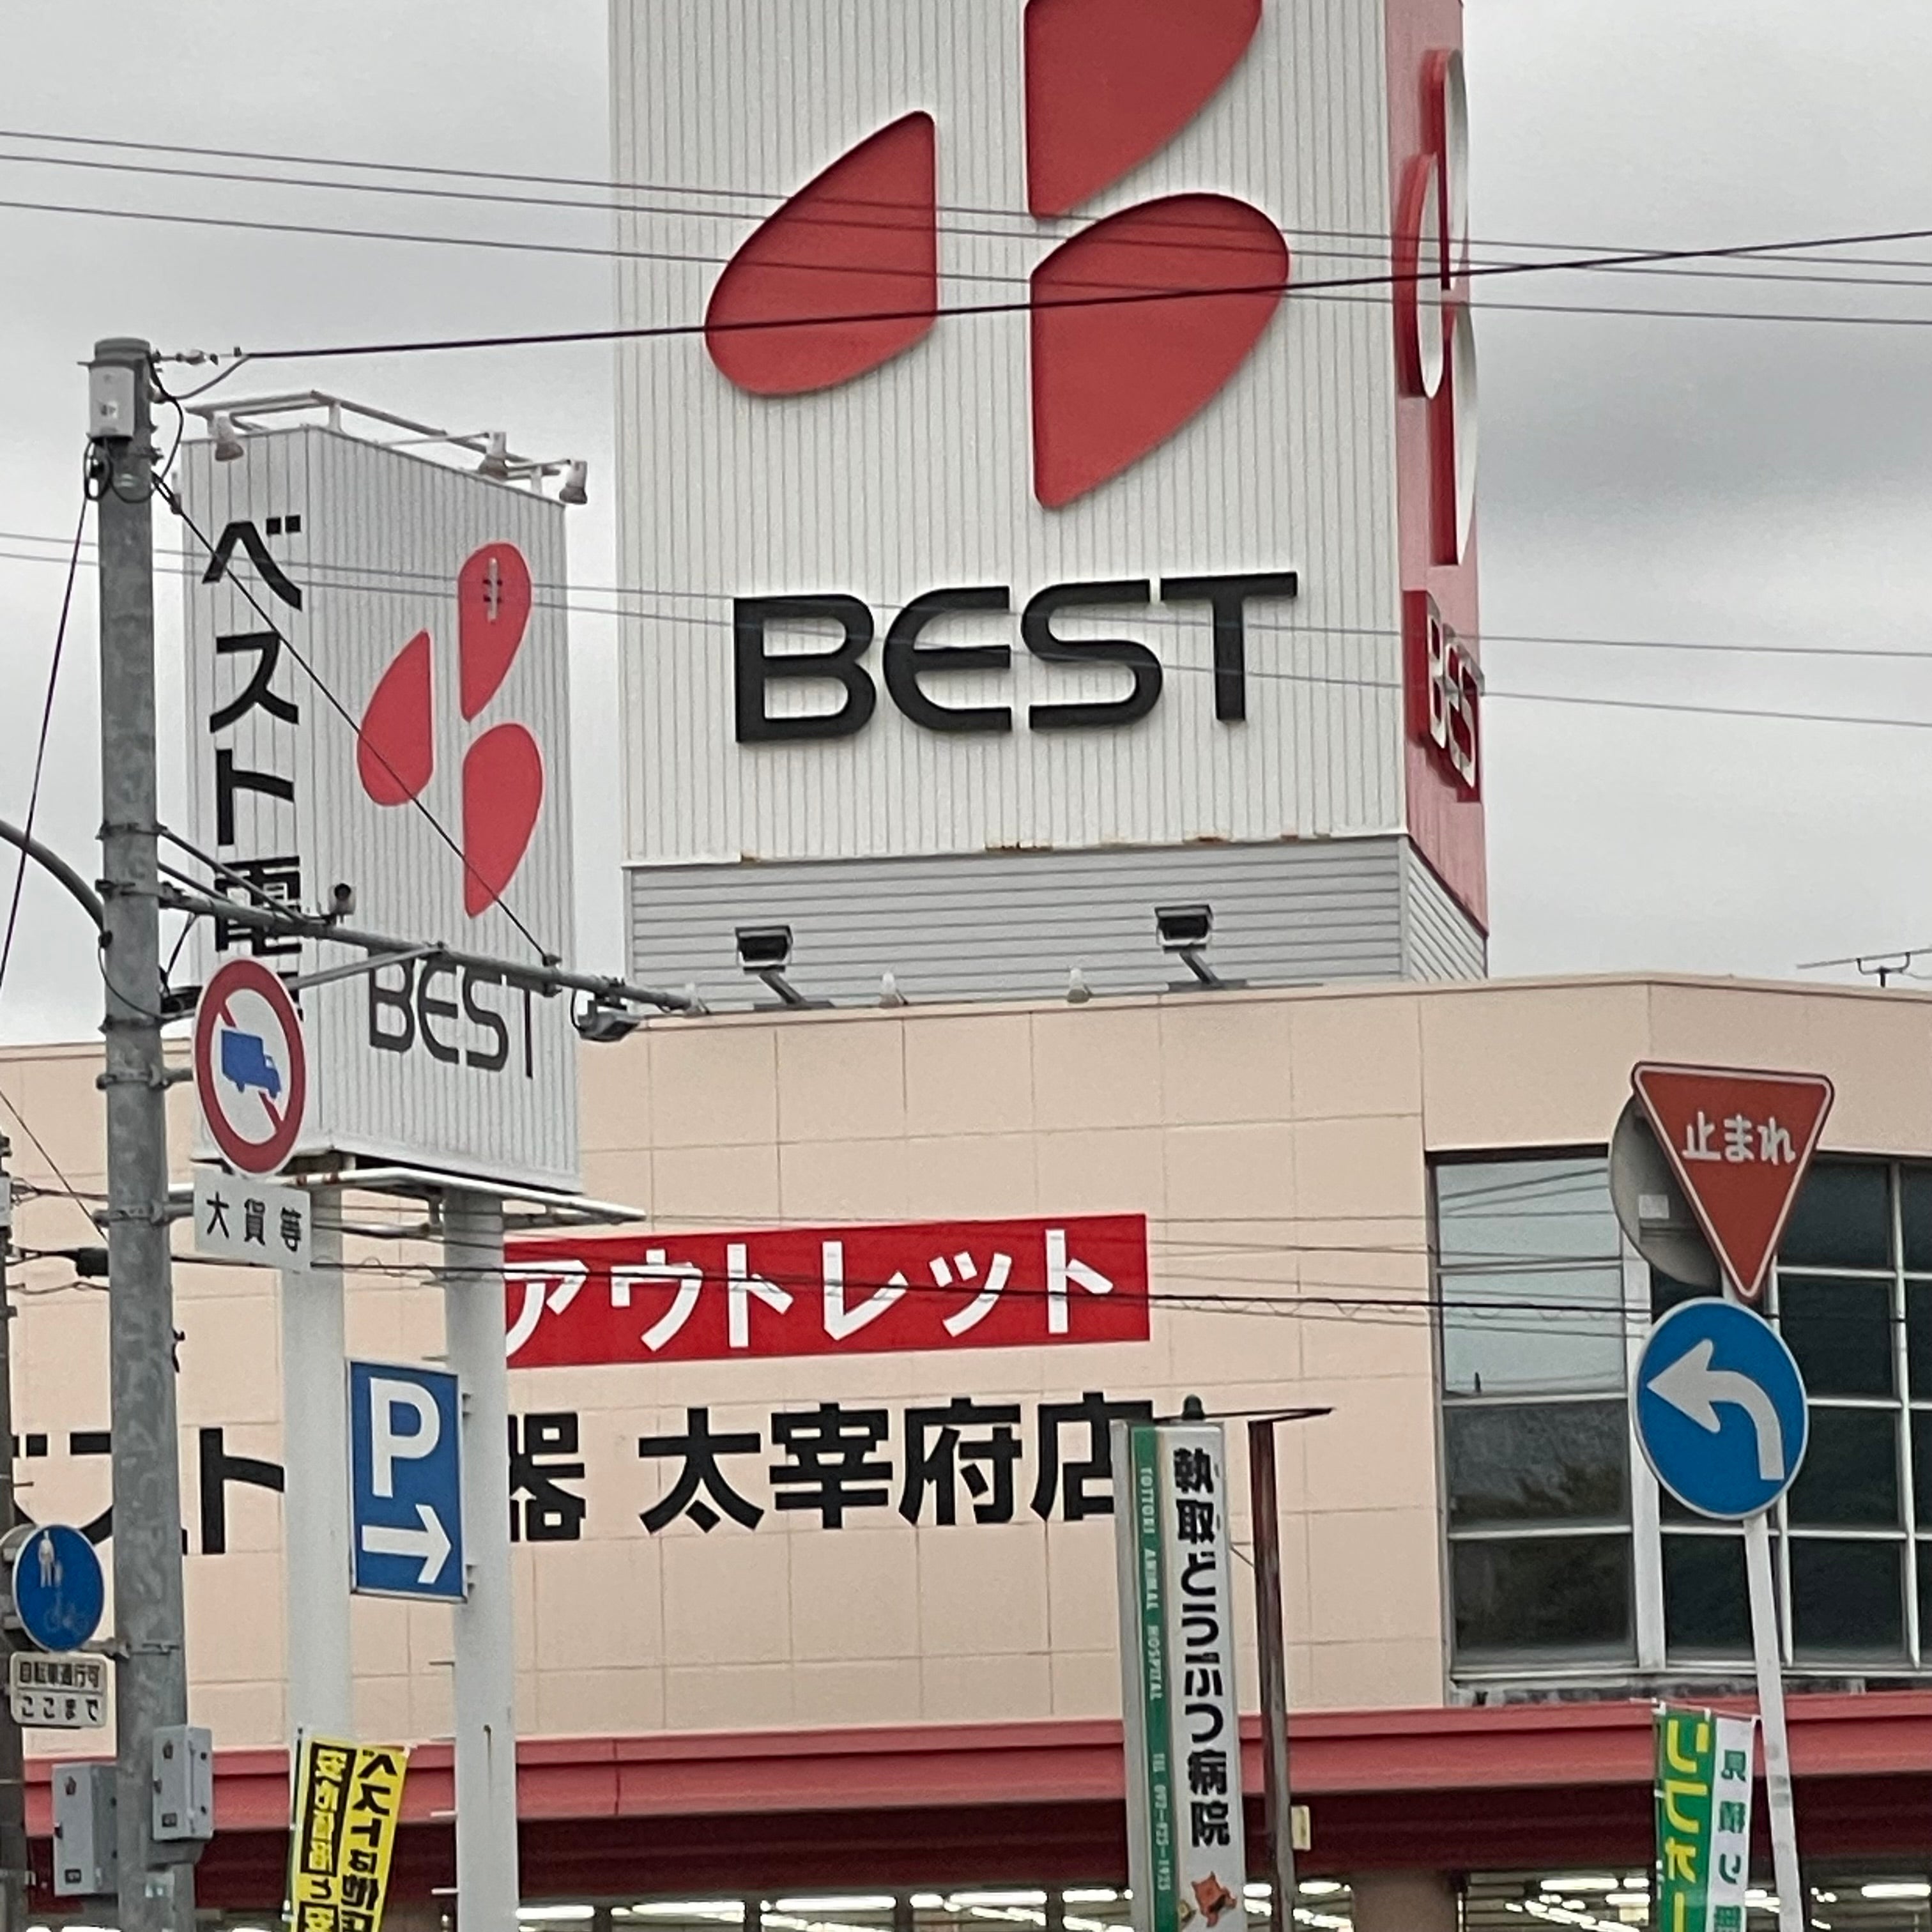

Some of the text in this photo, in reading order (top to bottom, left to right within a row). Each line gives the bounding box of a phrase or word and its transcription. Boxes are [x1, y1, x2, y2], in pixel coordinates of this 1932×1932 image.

[733, 571, 1298, 743] BEST
[202, 514, 303, 1022] ベスト電
[368, 946, 544, 1079] BEST
[1682, 1110, 1796, 1165] 止まれ
[206, 1191, 302, 1252] 大貨等
[505, 1228, 1114, 1357] アウトレット
[370, 1377, 440, 1498] P
[638, 1391, 1153, 1533] 太宰府店
[21, 1696, 98, 1722] ここまで
[1148, 1625, 1163, 1701] HOSPITAL
